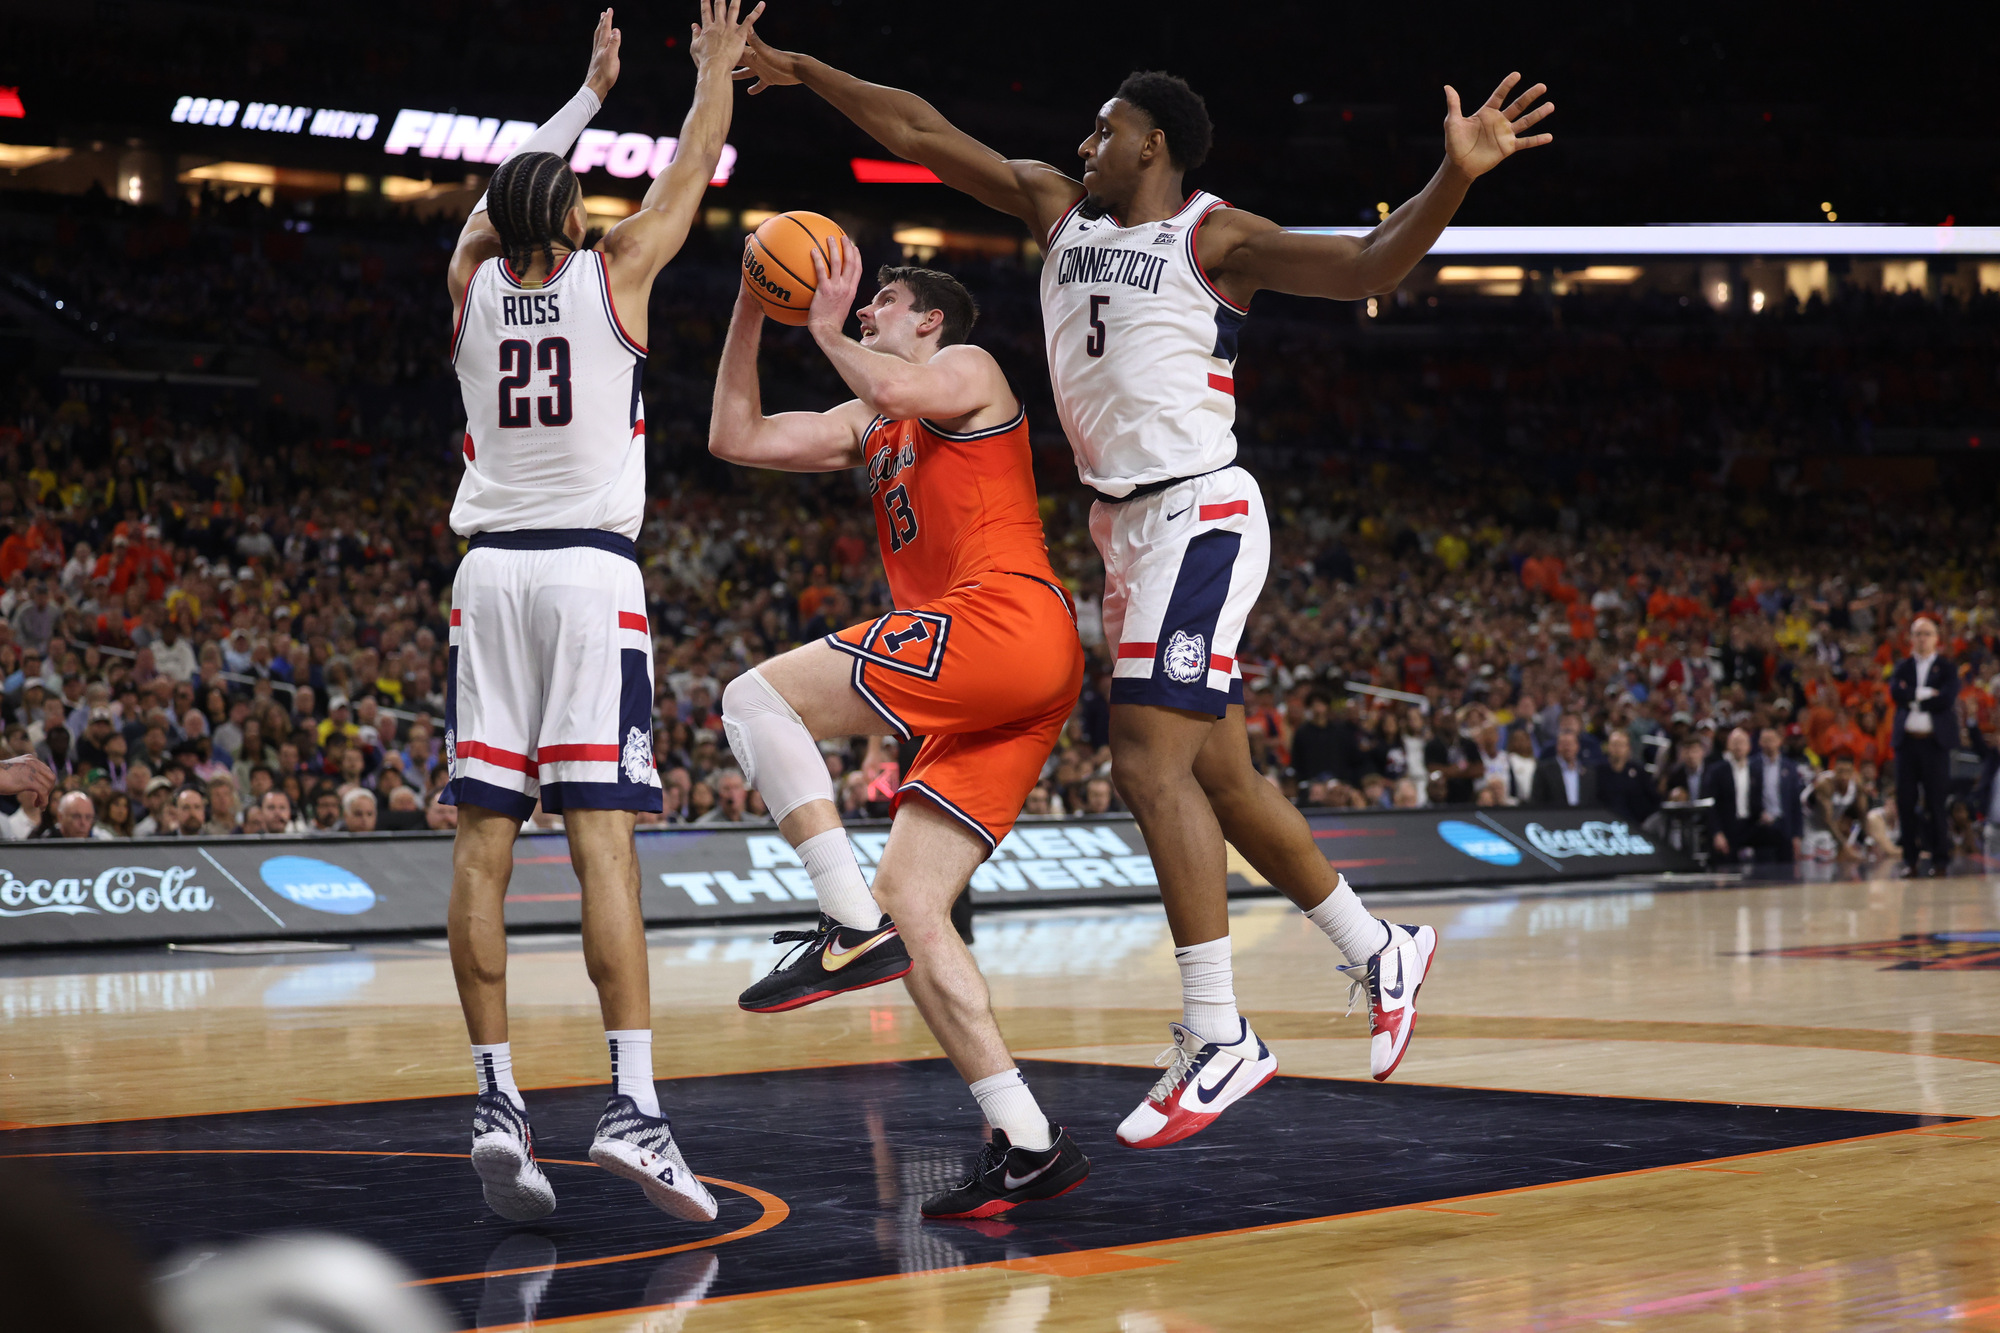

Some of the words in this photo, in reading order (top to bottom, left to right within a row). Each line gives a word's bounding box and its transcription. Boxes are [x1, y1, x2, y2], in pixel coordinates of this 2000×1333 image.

[241, 102, 304, 134] NCAA
[384, 108, 539, 165] FINA
[744, 243, 792, 303] Wilson
[1058, 246, 1168, 295] CONNECTICUT
[502, 294, 560, 326] ROSS
[1086, 294, 1110, 358] 5
[498, 336, 573, 428] 23
[884, 482, 919, 554] 13
[989, 826, 1133, 860] HEN
[284, 882, 375, 900] NCAA
[660, 866, 878, 905] THE
